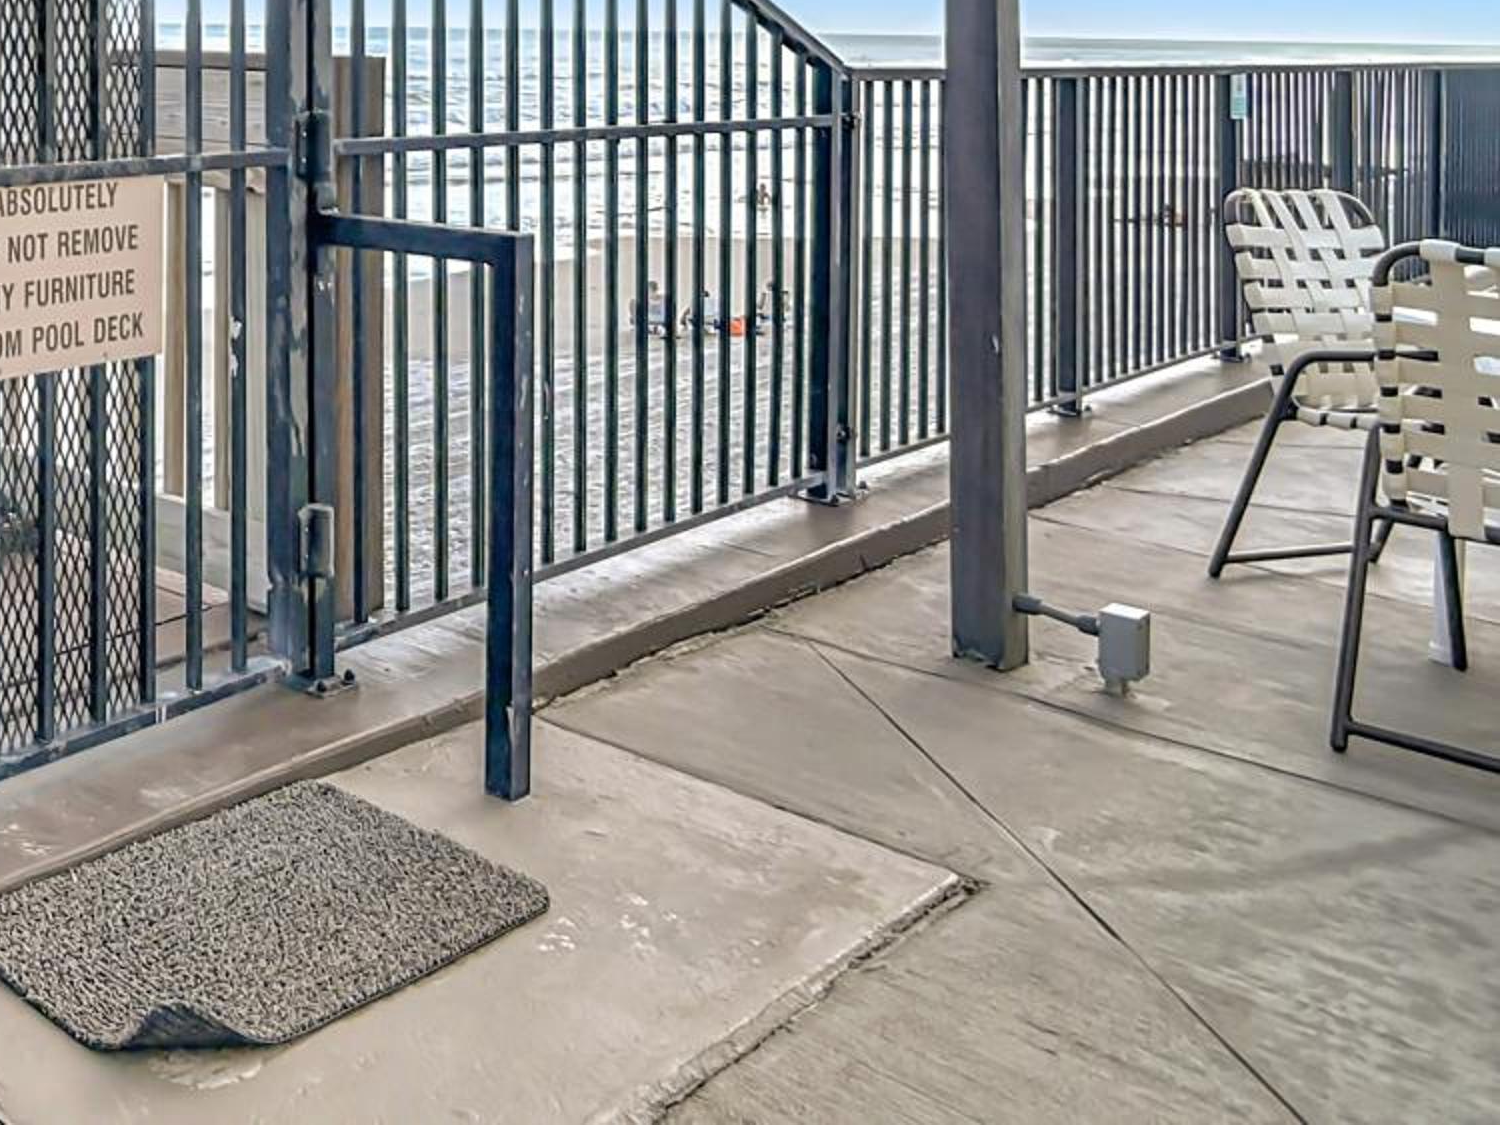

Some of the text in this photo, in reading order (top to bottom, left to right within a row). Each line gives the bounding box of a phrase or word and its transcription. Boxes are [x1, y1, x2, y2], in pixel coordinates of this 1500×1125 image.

[7, 232, 49, 264] NOT
[57, 224, 139, 258] REMOVE
[24, 268, 135, 308] FURNITURE
[32, 320, 85, 354] POOL
[93, 311, 143, 344] DECK
